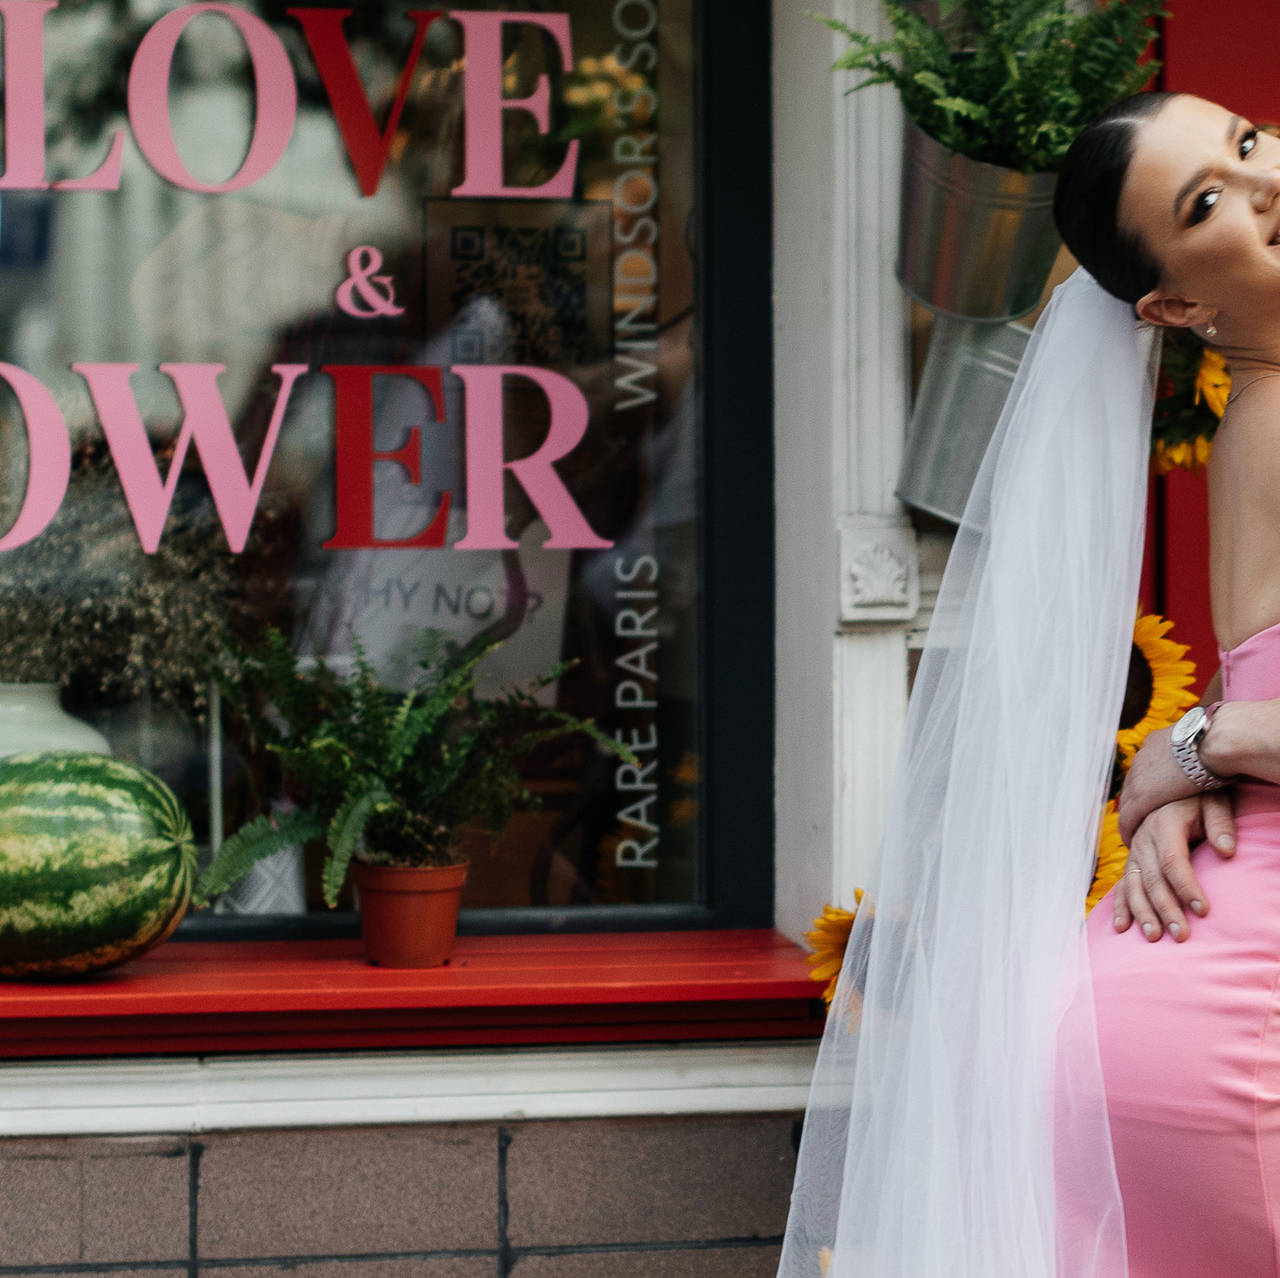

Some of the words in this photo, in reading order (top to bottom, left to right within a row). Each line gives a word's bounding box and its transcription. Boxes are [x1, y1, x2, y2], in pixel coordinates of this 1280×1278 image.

[335, 245, 405, 319] &
[611, 85, 659, 412] WINDSOR'S
[432, 581, 545, 624] NO?
[613, 553, 660, 709] PARIS
[613, 724, 660, 868] RARE
